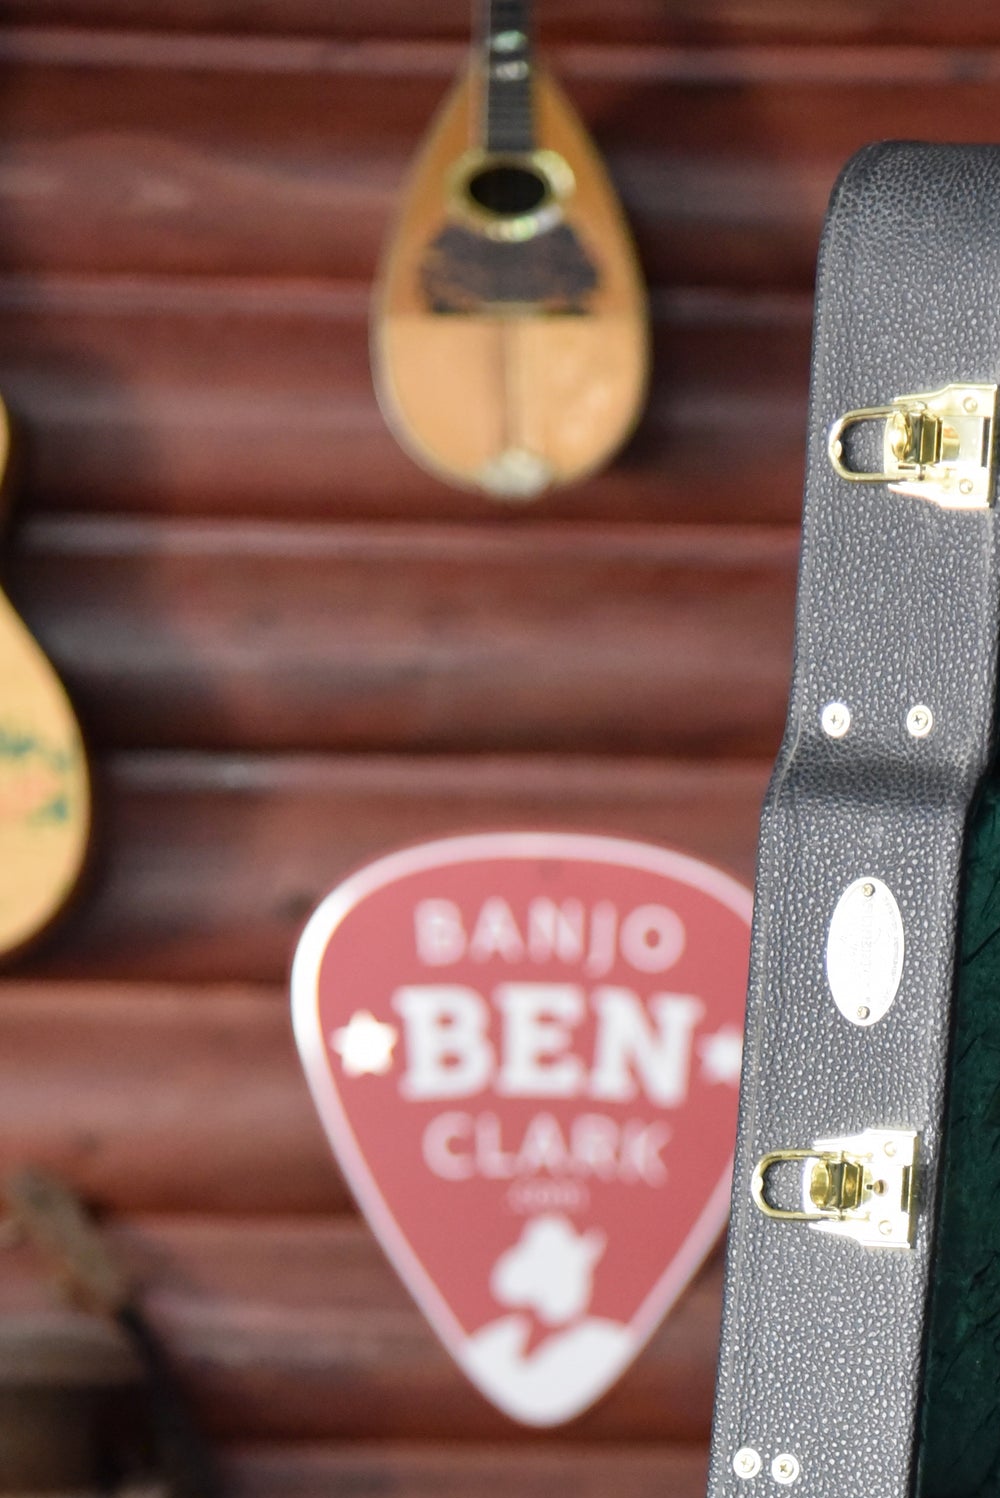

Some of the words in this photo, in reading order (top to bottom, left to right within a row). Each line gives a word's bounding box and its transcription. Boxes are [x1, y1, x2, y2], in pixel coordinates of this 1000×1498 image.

[413, 898, 686, 976] BANJO
[394, 984, 704, 1108] BEN
[422, 1112, 673, 1185] CLARK
